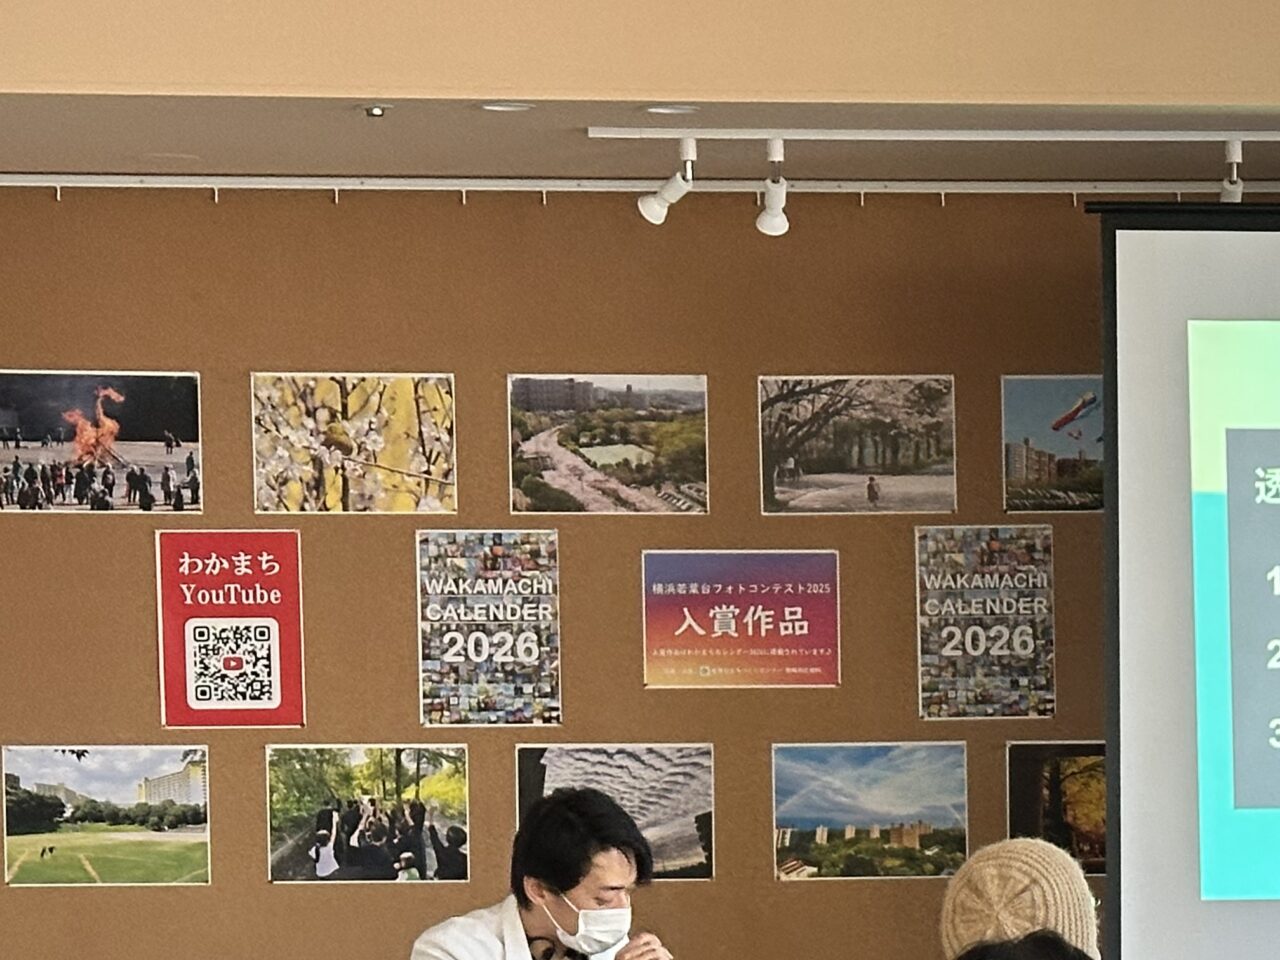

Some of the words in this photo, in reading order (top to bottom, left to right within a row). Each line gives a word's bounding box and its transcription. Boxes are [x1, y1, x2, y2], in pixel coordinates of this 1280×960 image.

[178, 551, 281, 577] わかまち
[425, 578, 553, 596] WAKAMACHI
[924, 573, 1048, 590] WAKAMACHI
[179, 583, 281, 605] YouTube
[426, 603, 553, 621] CALENDER
[924, 598, 1049, 615] CALENDER
[674, 604, 809, 637] 入賞作品
[443, 631, 540, 663] 2026
[941, 625, 1035, 656] 2026
